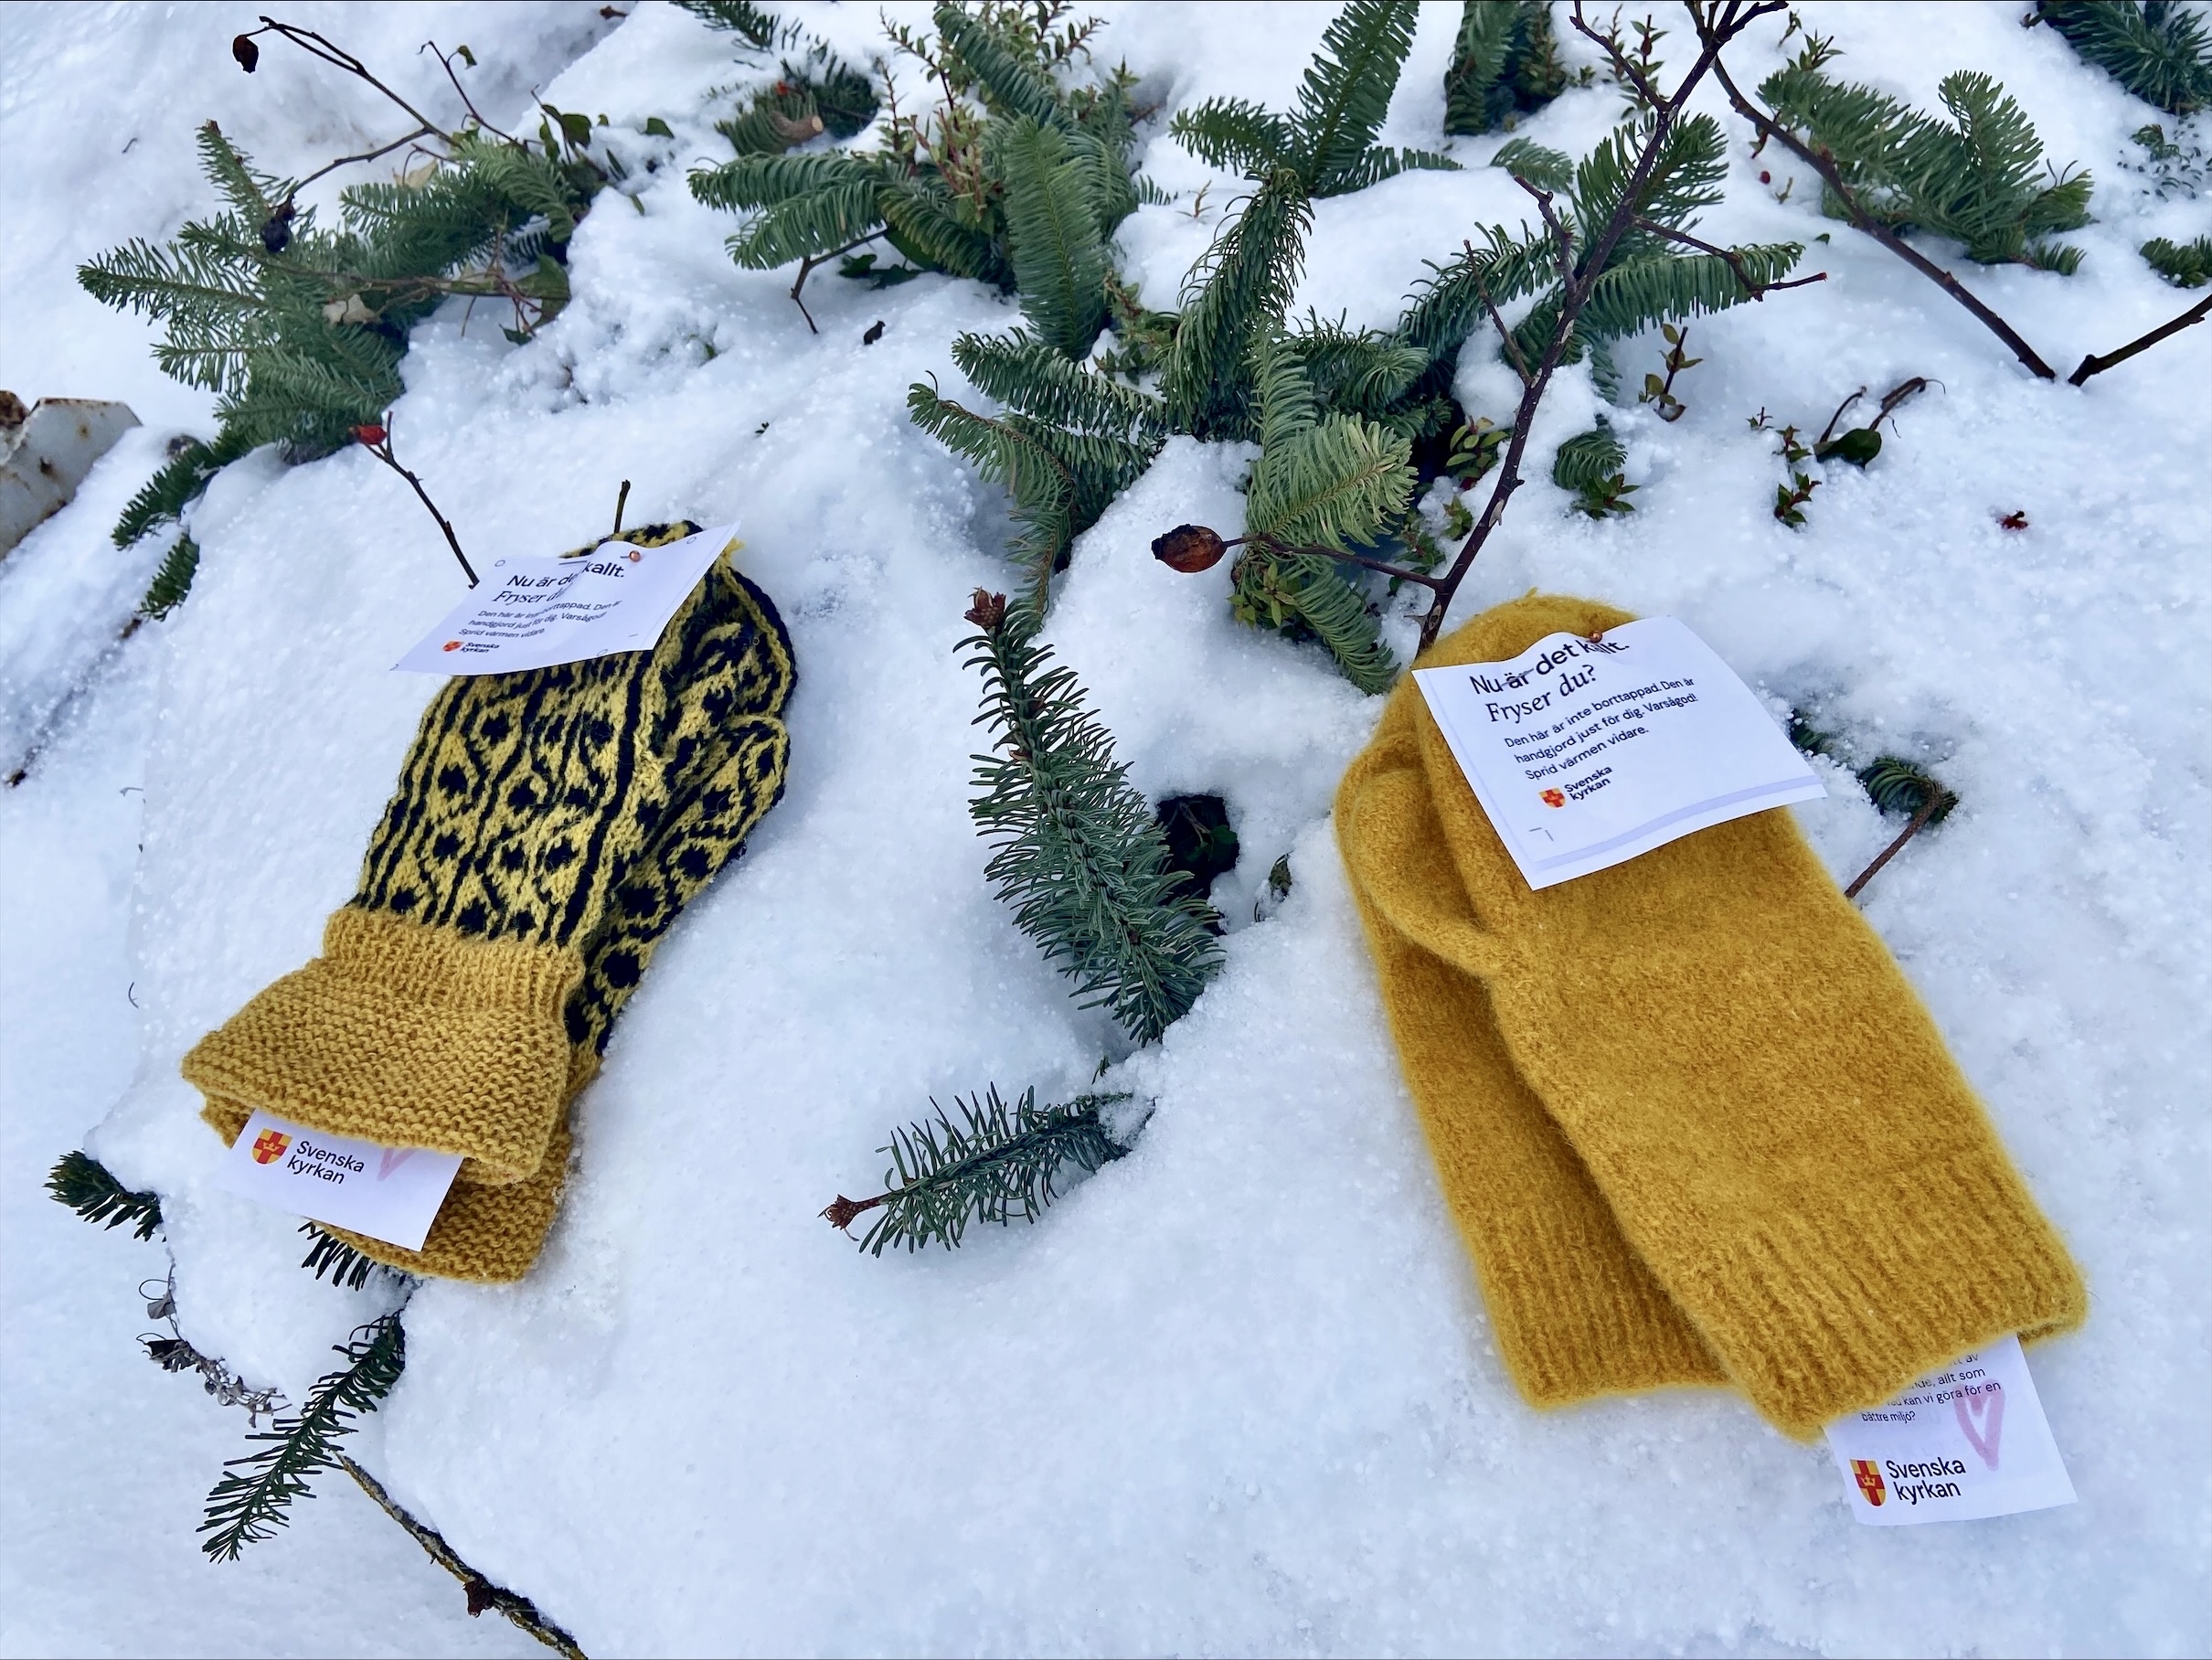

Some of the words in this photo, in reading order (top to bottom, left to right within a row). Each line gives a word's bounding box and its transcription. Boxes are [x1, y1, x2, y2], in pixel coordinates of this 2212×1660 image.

[506, 575, 536, 587] Nu
[536, 577, 557, 587] är
[582, 561, 625, 578] kallt.
[492, 590, 547, 606] Fryser
[459, 628, 485, 636] Sprid
[468, 619, 516, 629] handgjord
[1469, 675, 1503, 695] Nu
[1505, 671, 1530, 690] är
[1536, 643, 1579, 676] det
[1485, 690, 1552, 724] Fryser
[1559, 664, 1597, 697] du?
[1504, 735, 1530, 748] Den
[1531, 726, 1550, 742] här
[1552, 722, 1566, 734] är
[1567, 708, 1592, 726] inte
[1591, 683, 1663, 712] borttappad.
[1660, 680, 1684, 691] Den
[1682, 677, 1695, 686] är
[1514, 735, 1578, 764] handgjord
[1577, 723, 1602, 743] just
[1601, 713, 1621, 731] för
[1622, 706, 1645, 720] dig.
[1643, 692, 1699, 712] Varsågod!
[1525, 764, 1558, 782] Sprid
[1558, 742, 1607, 770] värmen
[1608, 725, 1649, 746] vidare.
[1564, 765, 1613, 793] Svenska
[1569, 778, 1611, 801] kyrkan
[287, 1155, 346, 1185] kyrkan
[297, 1141, 365, 1173] Svenska
[1937, 1373, 1957, 1387] allt
[1959, 1367, 1986, 1381] som
[1903, 1394, 1921, 1407] kan
[1923, 1392, 1934, 1403] vi
[1936, 1387, 1963, 1404] göra
[1964, 1385, 1982, 1398] för
[1985, 1381, 2002, 1393] en
[1861, 1411, 1889, 1422] bättre
[1890, 1410, 1917, 1424] miljö?
[1886, 1456, 1966, 1479] Svenska
[1893, 1480, 1962, 1506] kyrkan
